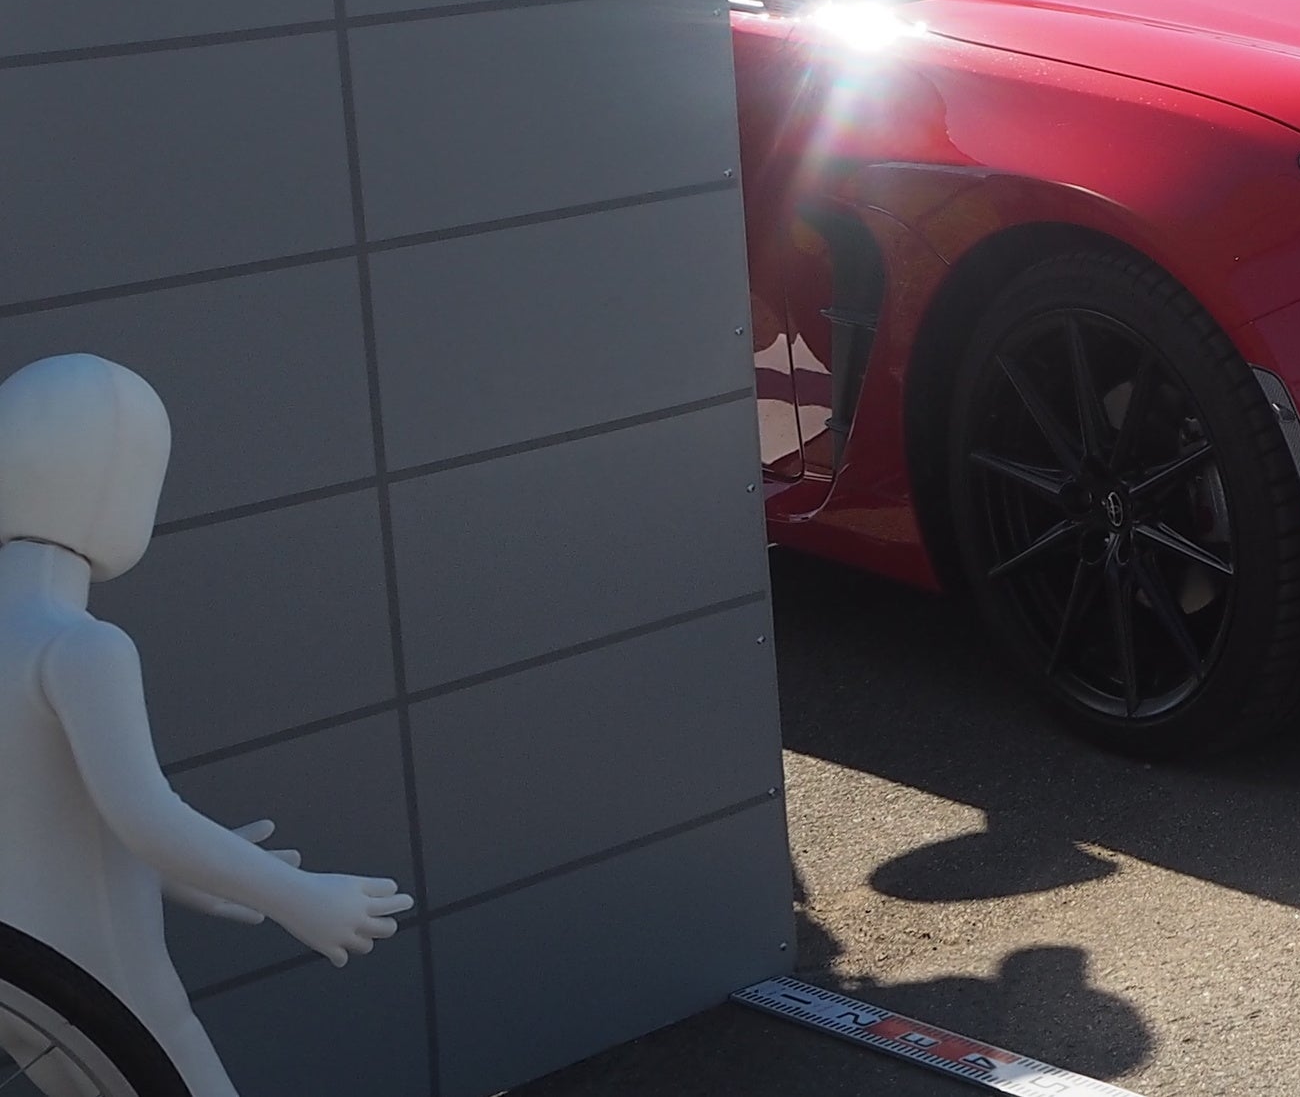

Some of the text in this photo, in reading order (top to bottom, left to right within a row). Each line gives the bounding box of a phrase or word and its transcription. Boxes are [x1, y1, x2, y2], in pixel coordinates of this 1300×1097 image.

[836, 1011, 877, 1026] 2
[900, 1032, 938, 1048] 3
[962, 1056, 997, 1070] 4
